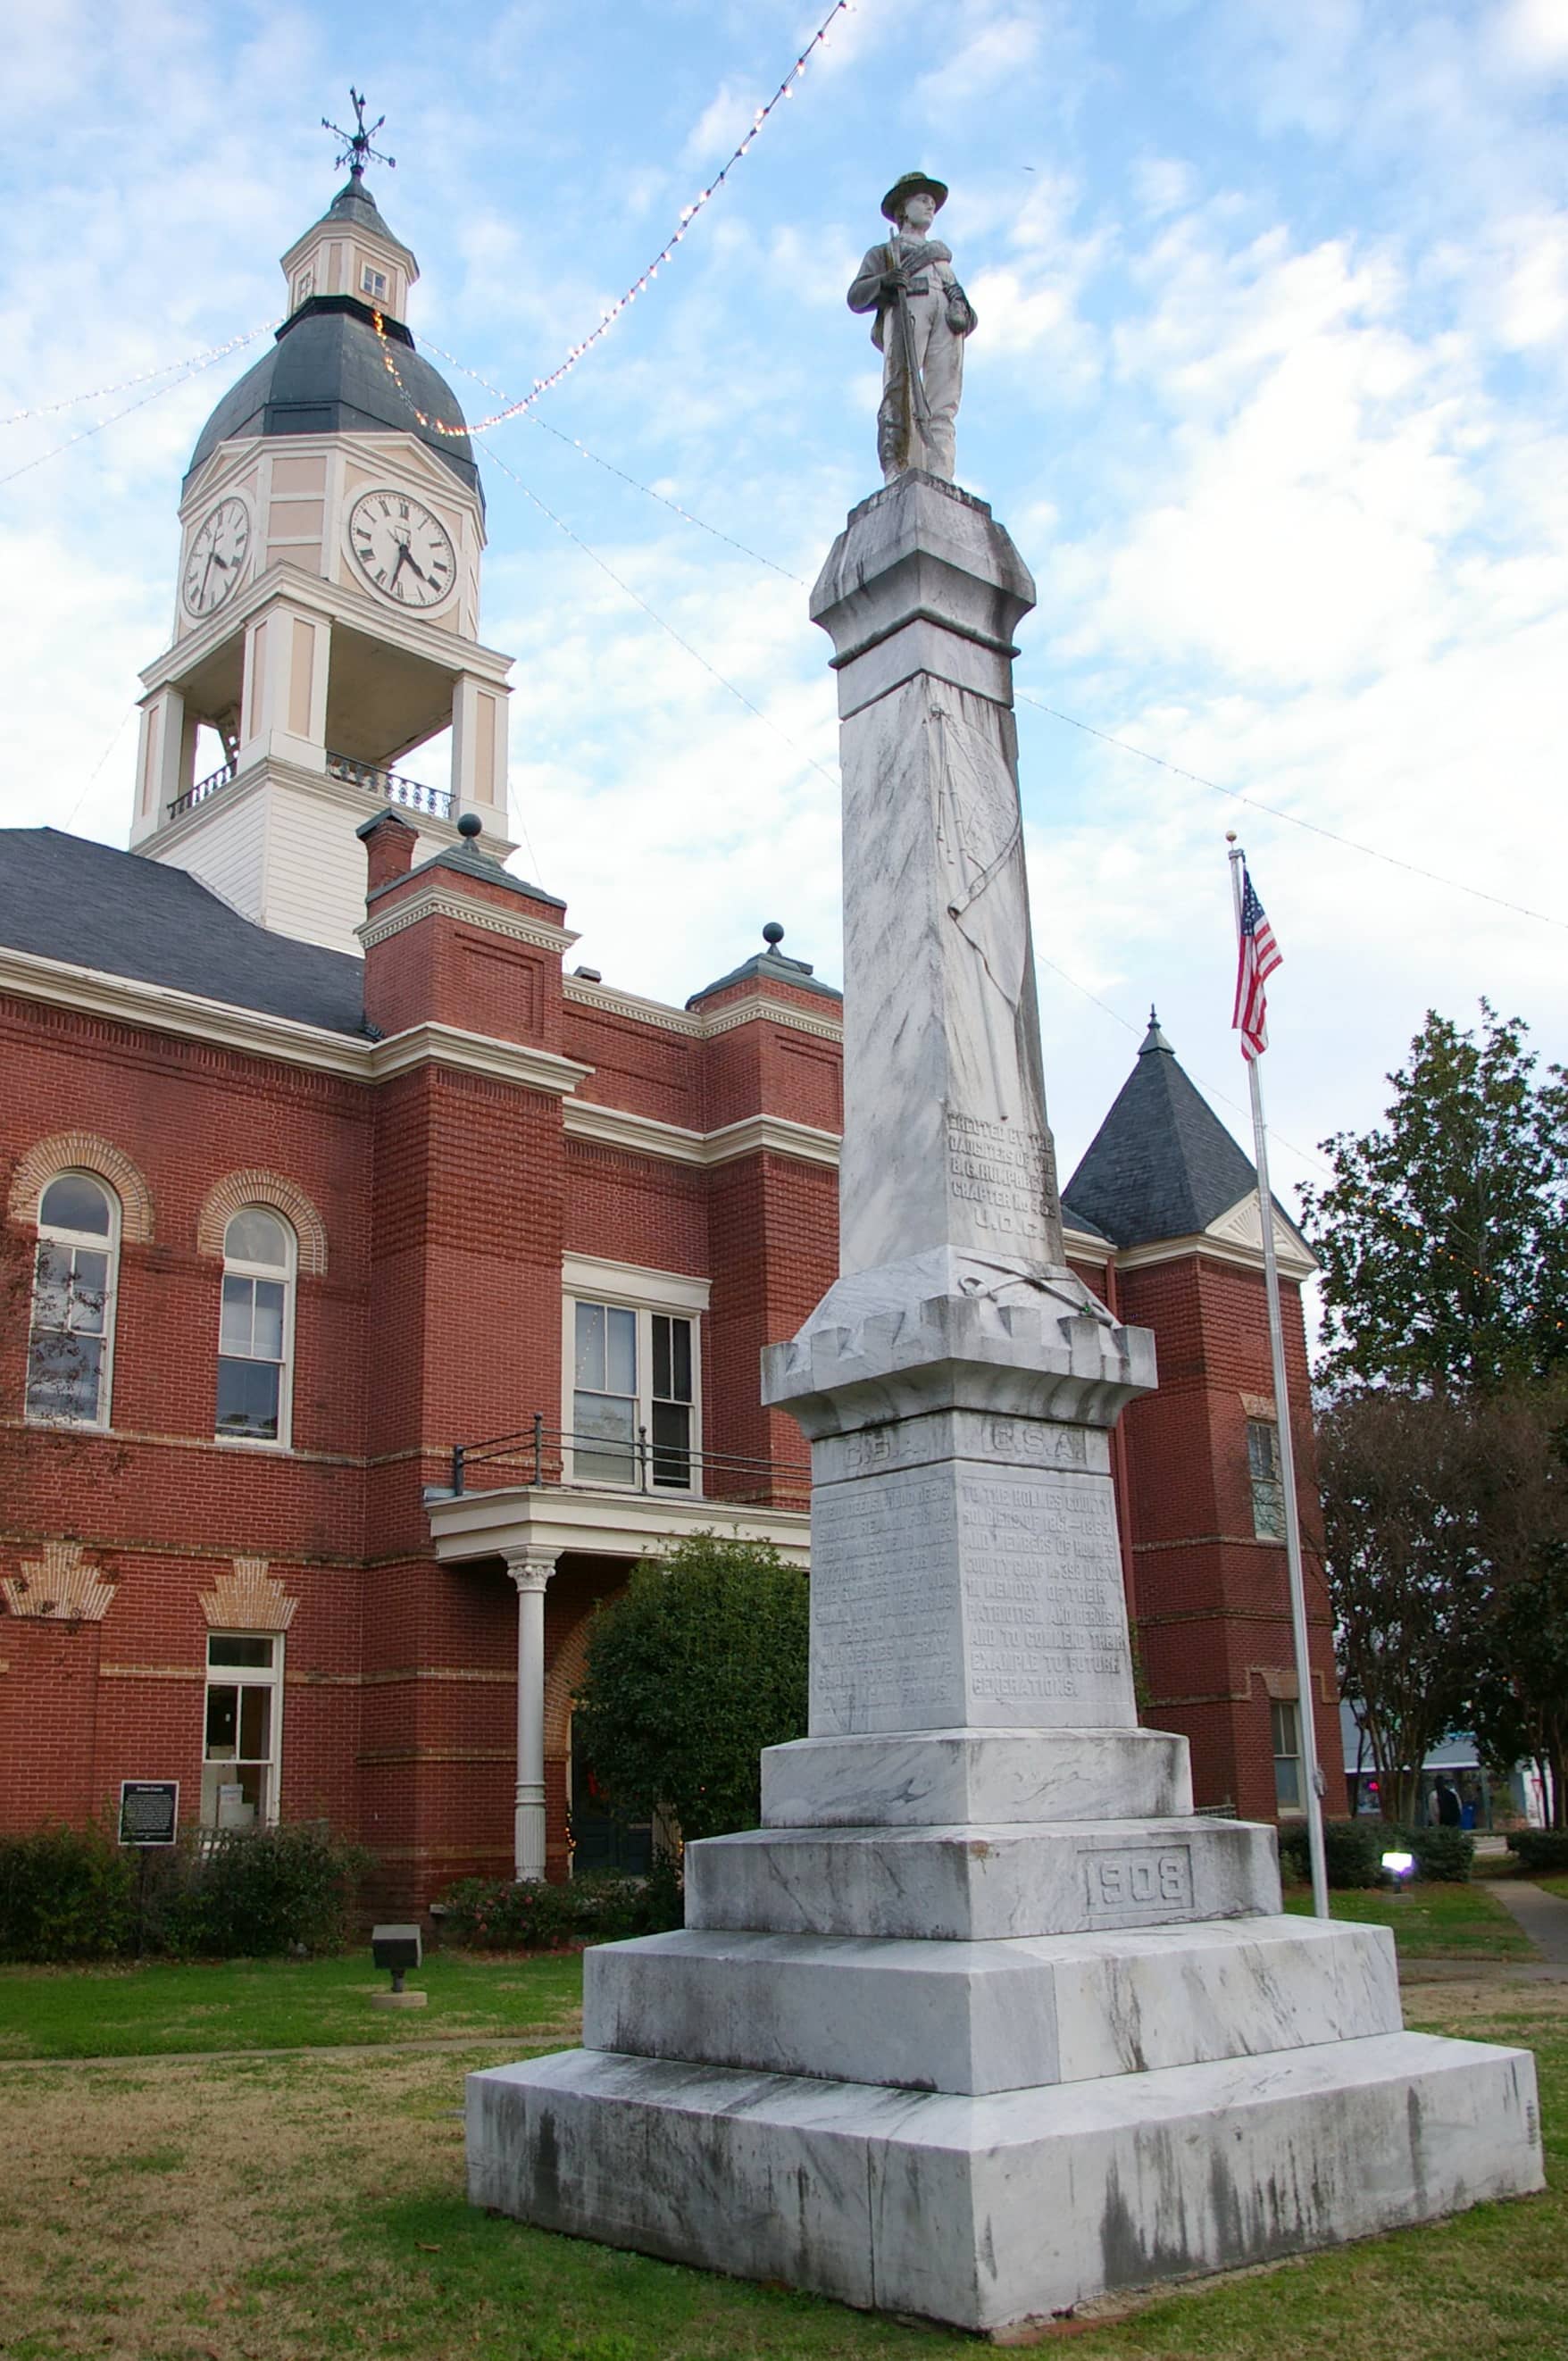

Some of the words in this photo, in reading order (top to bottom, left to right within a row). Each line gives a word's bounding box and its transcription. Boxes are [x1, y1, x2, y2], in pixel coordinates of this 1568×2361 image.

[962, 1483, 980, 1504] TO
[983, 1485, 1008, 1506] THE
[1012, 1489, 1063, 1511] HOLMES
[1064, 1493, 1108, 1514] COUNTY
[963, 1506, 1021, 1529] SOLDIERS
[1020, 1510, 1040, 1531] OF
[963, 1529, 988, 1550] AND
[993, 1531, 1050, 1555] MEMBERS
[1072, 1537, 1114, 1559] HOLMES
[963, 1554, 1008, 1575] COUNTY
[984, 1579, 1038, 1600] MEMORY
[1063, 1583, 1105, 1604] THEIR
[1045, 1604, 1072, 1626] AND
[970, 1624, 993, 1647] AND
[998, 1625, 1019, 1647] TO
[970, 1649, 1038, 1672] EXAMPLE
[1042, 1652, 1062, 1673] TO
[1065, 1652, 1120, 1673] FUTURE
[1085, 1856, 1183, 1905] 1908
